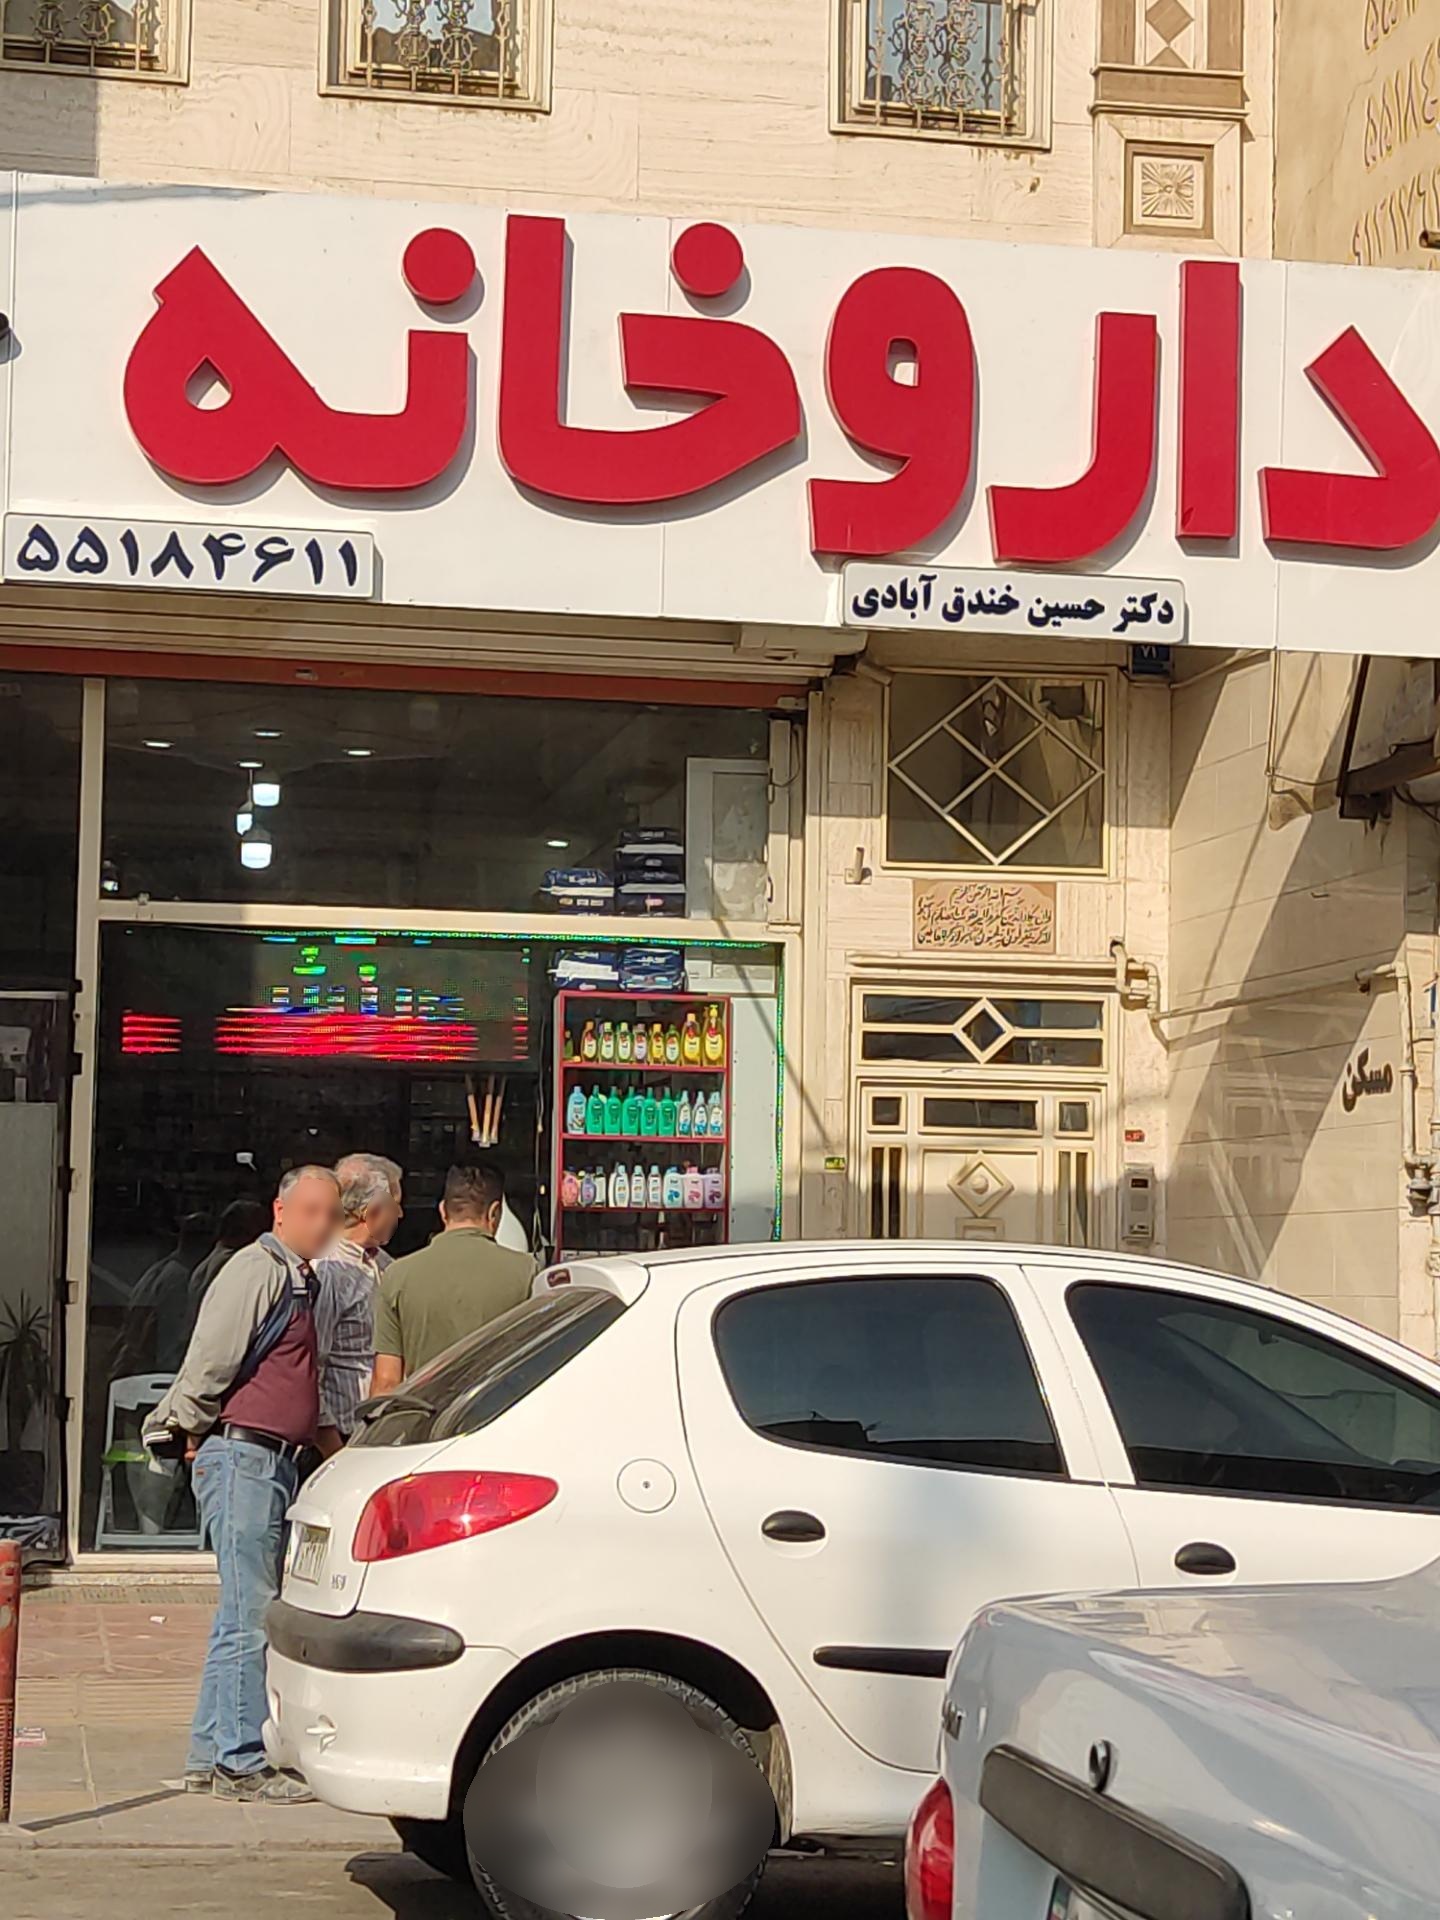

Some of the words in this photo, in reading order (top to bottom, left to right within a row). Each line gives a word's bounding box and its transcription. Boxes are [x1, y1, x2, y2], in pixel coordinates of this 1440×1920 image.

[124, 214, 1440, 560] داروخانه
[17, 523, 357, 587] ۵۵۱۸۴۶۱۱
[852, 574, 938, 619] آبادی
[941, 584, 1020, 623] خندق
[1027, 597, 1105, 628] حسین
[1112, 592, 1174, 633] دکتر
[1342, 1047, 1394, 1113] مسکن
